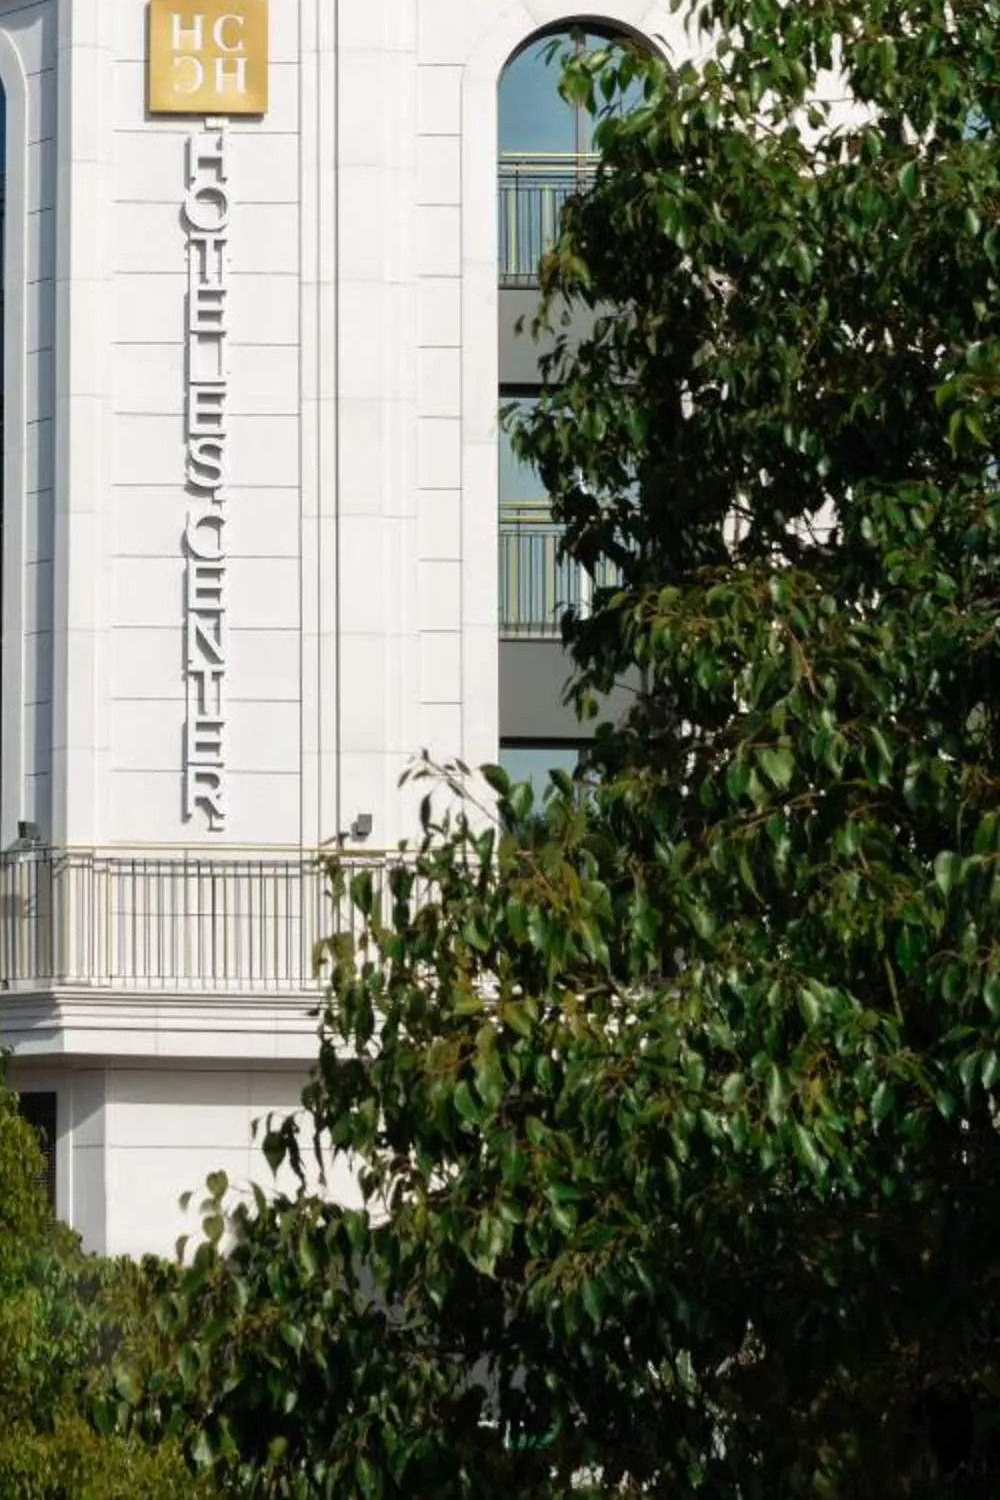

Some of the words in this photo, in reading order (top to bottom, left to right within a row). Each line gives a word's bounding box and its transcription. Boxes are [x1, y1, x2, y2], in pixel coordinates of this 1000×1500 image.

[171, 13, 244, 52] HC
[184, 127, 231, 490] HOTELES
[185, 501, 229, 822] CENTER
